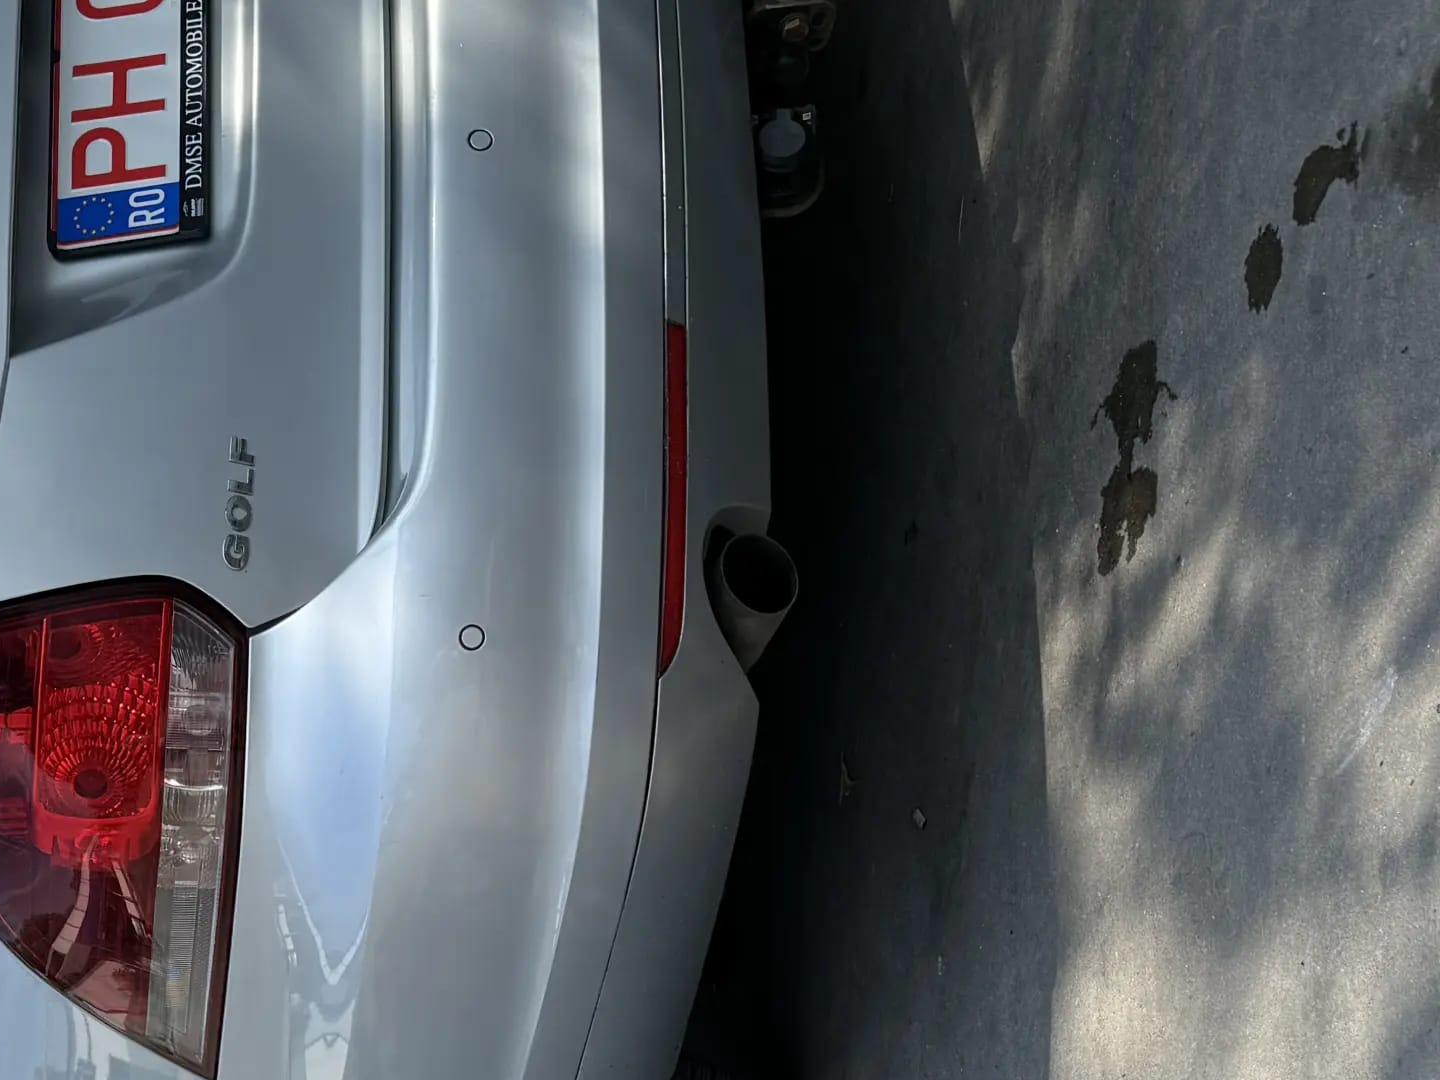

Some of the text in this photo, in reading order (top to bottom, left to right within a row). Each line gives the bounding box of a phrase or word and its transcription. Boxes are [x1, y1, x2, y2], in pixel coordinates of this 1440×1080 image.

[71, 53, 167, 190] PH
[185, 0, 203, 127] AUTOMOBILE
[128, 188, 166, 228] RO
[185, 132, 203, 191] DMSE
[222, 435, 255, 571] GOLF
